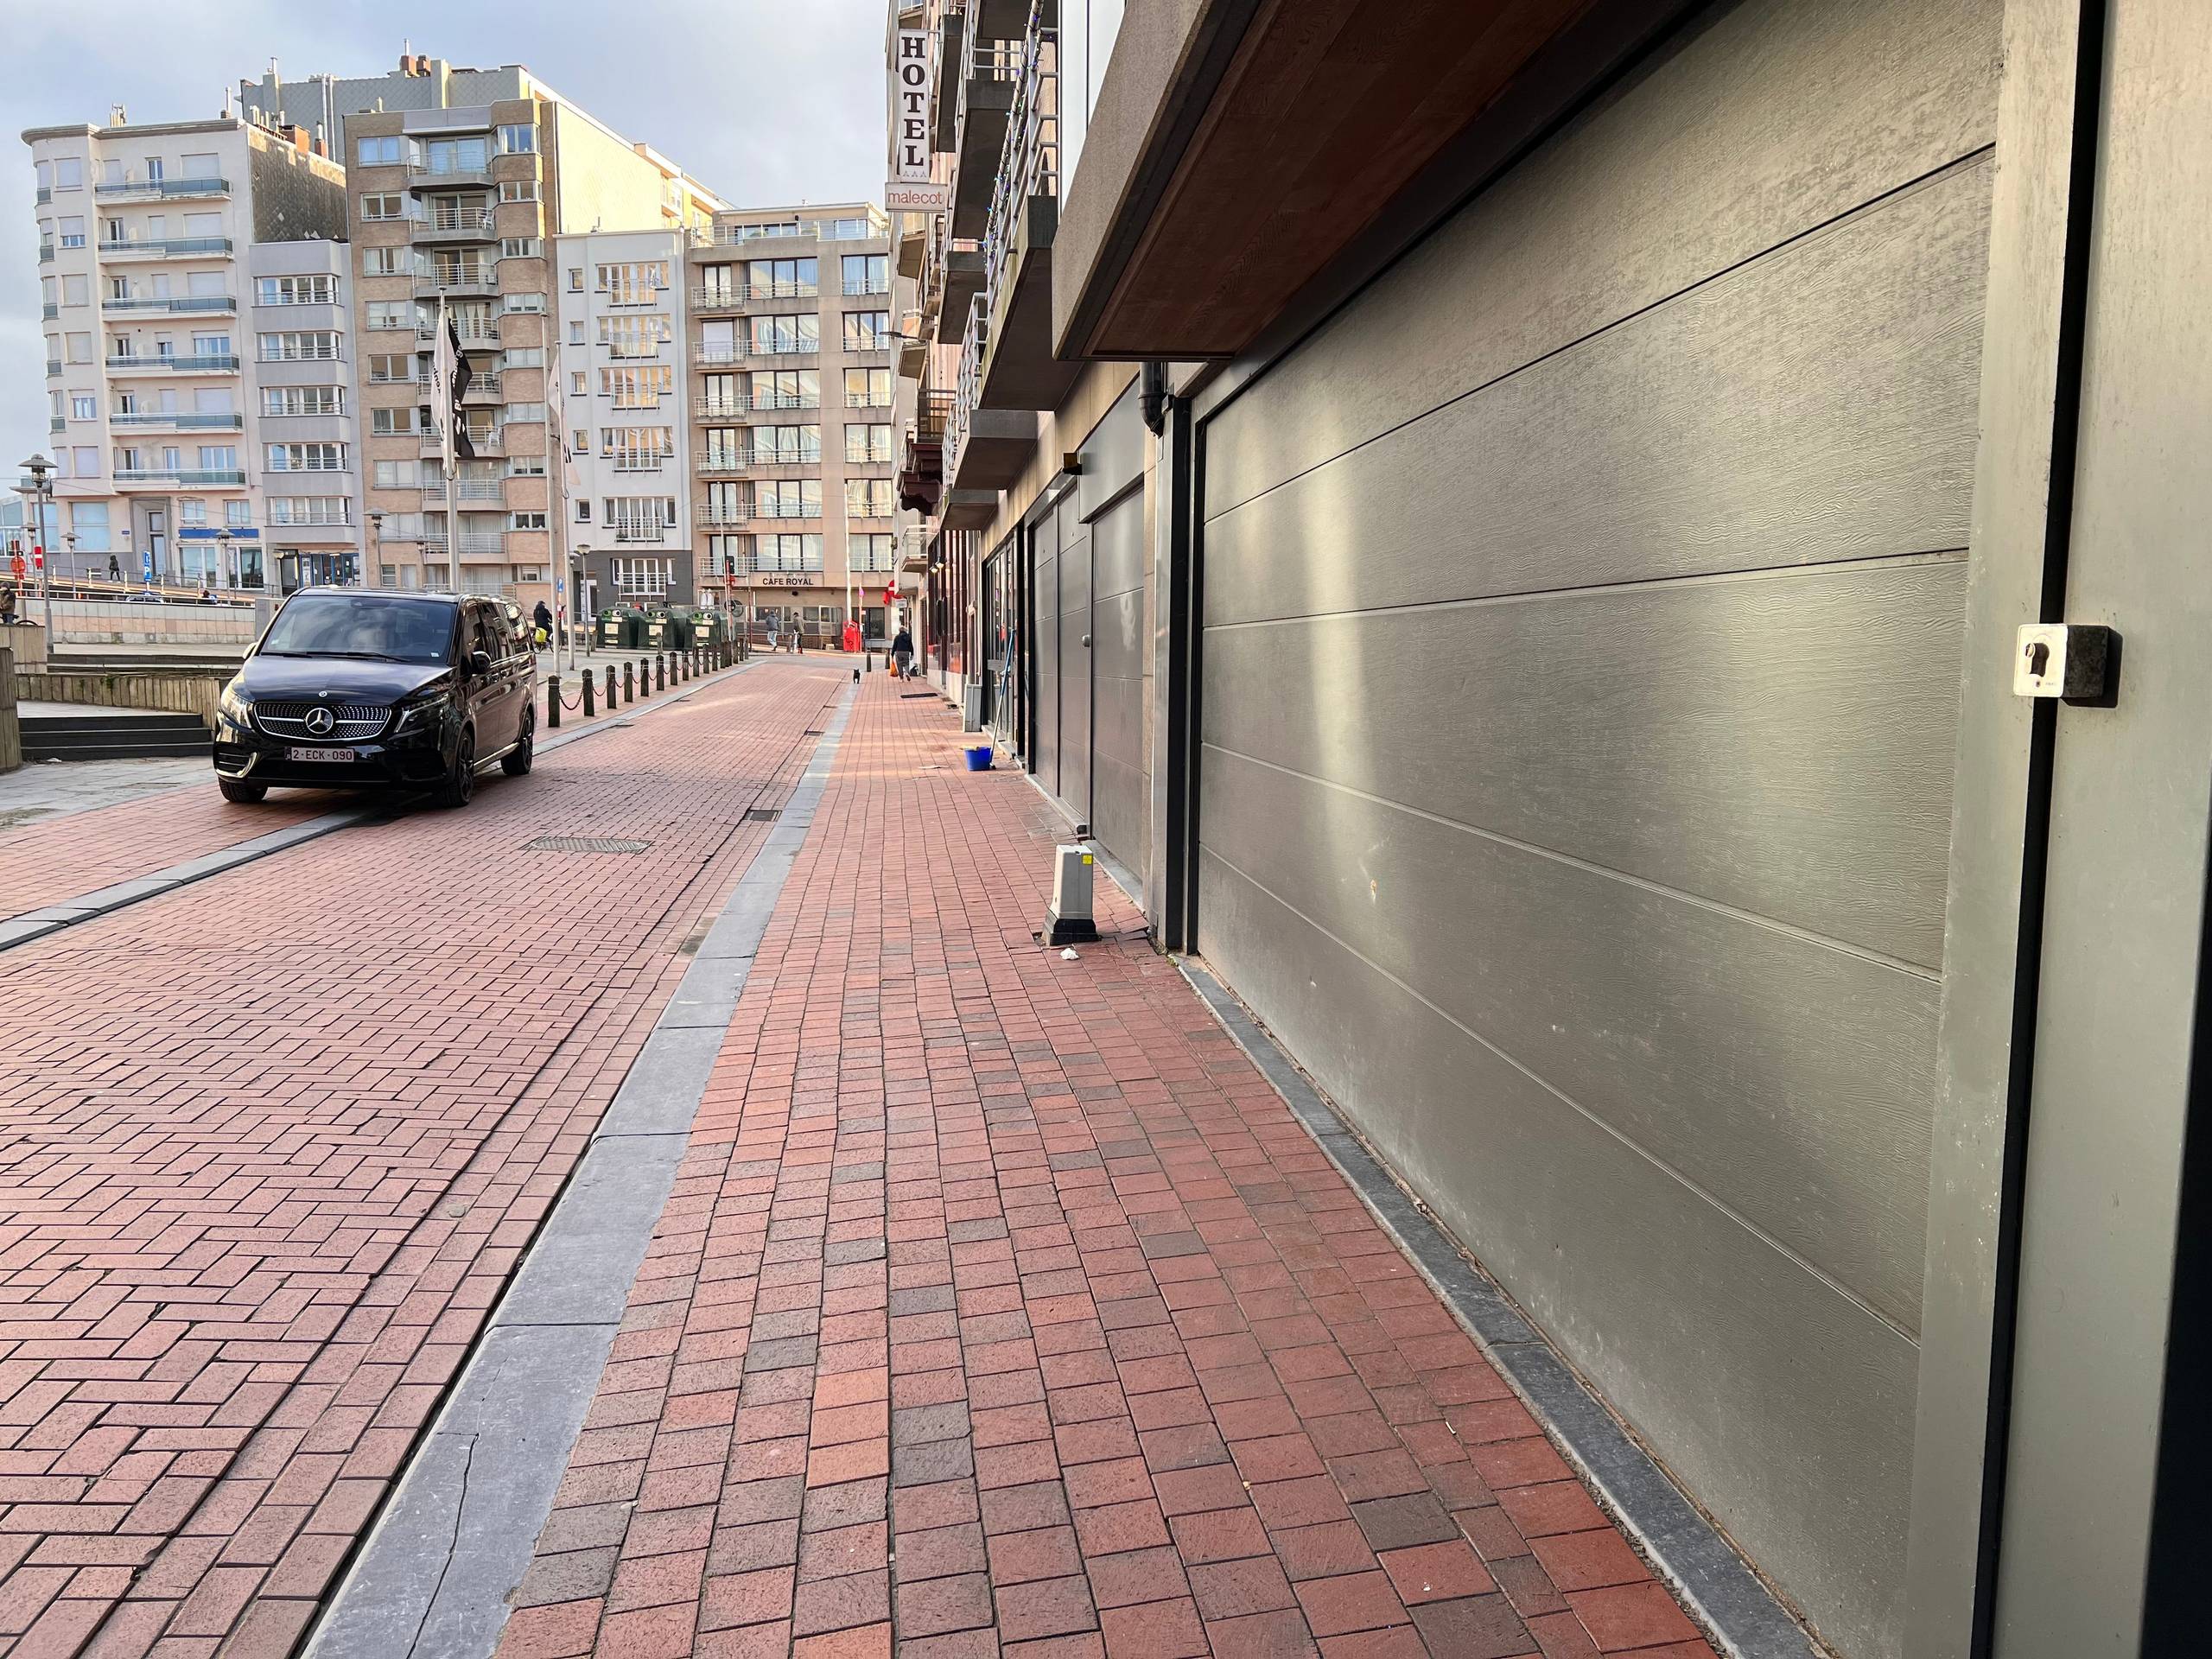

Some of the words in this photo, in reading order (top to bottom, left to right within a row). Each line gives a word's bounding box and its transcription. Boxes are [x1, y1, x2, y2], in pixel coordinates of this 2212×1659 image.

[901, 36, 926, 167] HOTEL
[887, 190, 943, 205] malecot
[762, 577, 784, 586] CAFE
[785, 577, 814, 586] ROYAL
